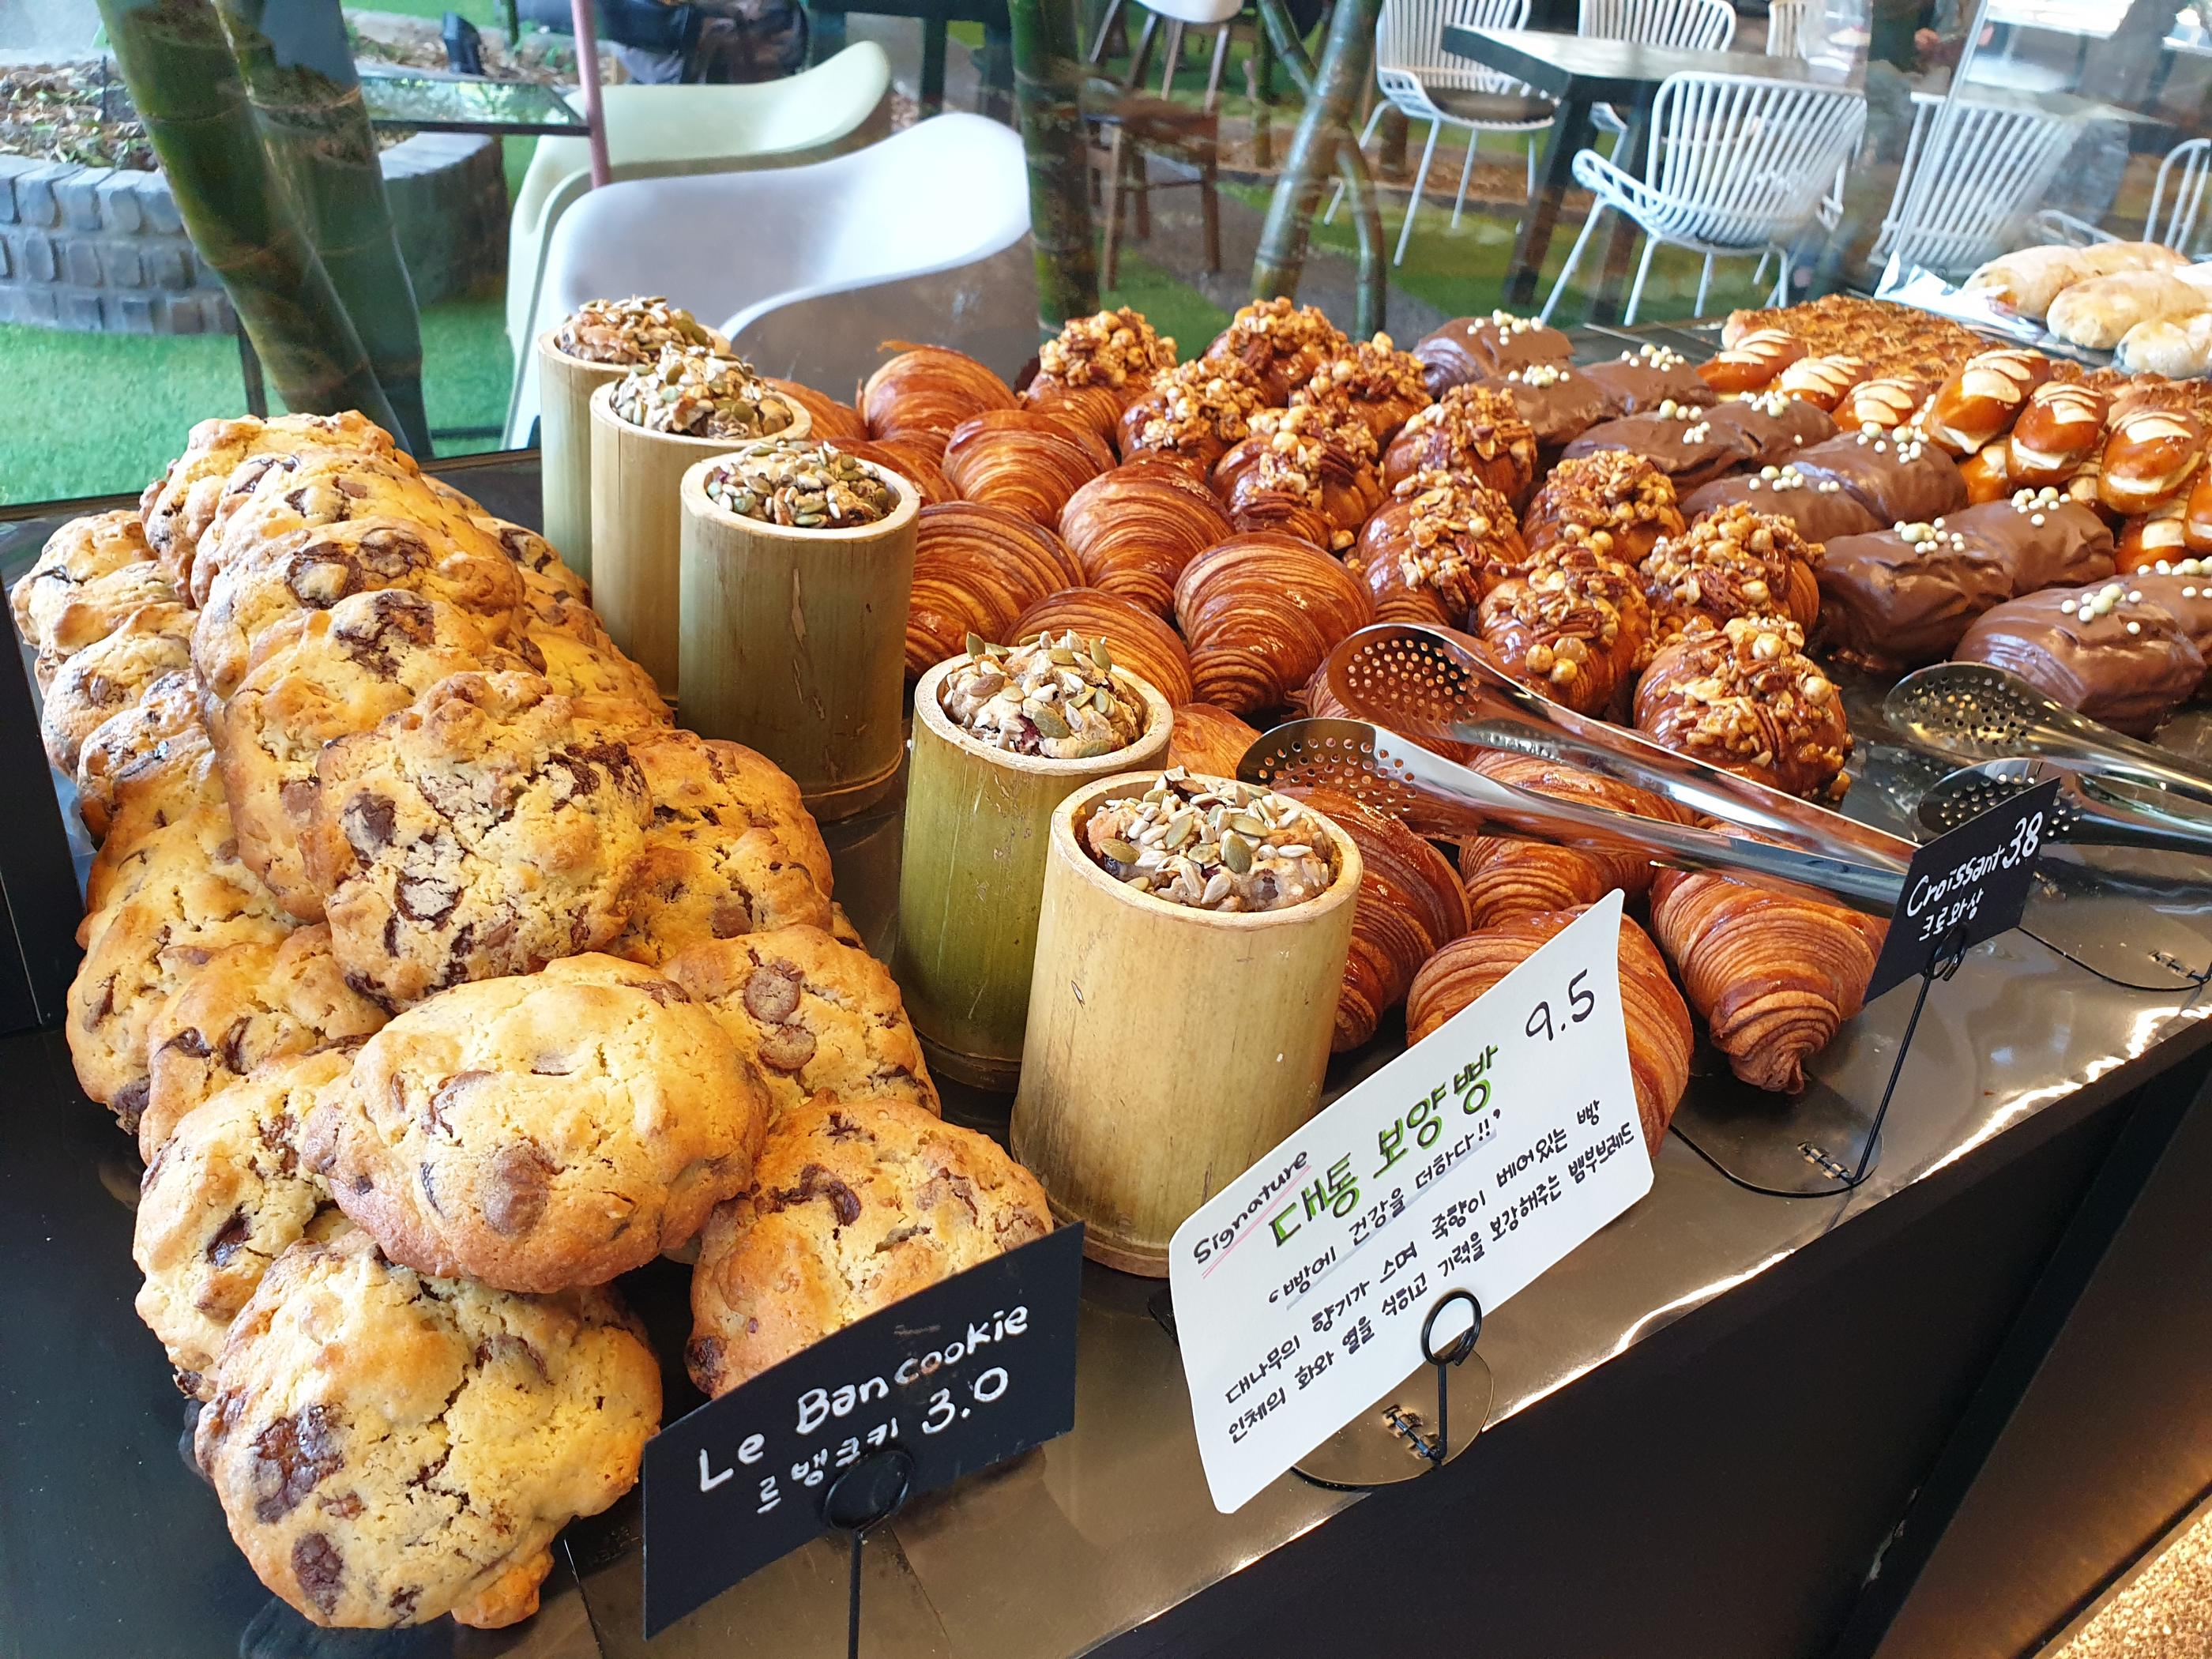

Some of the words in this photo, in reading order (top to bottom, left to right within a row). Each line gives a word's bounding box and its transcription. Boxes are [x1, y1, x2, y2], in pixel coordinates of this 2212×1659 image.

[1907, 845, 2004, 916] Croissant
[1525, 969, 1594, 1041] 9.5
[1193, 1150, 1308, 1265] Signature
[1349, 1187, 1405, 1246] 건강을
[1224, 1334, 1300, 1404] 대나무의
[1311, 1281, 1370, 1333] 향기가
[1379, 1241, 1418, 1284] 스며
[1577, 1100, 1601, 1126] 빵
[1228, 1386, 1286, 1444] 인체의
[1294, 1350, 1334, 1390] 화와
[1381, 1272, 1428, 1316] 식히고
[1437, 1232, 1485, 1277] 기력을
[922, 1367, 1009, 1435] 3.0
[699, 1432, 765, 1492] Le
